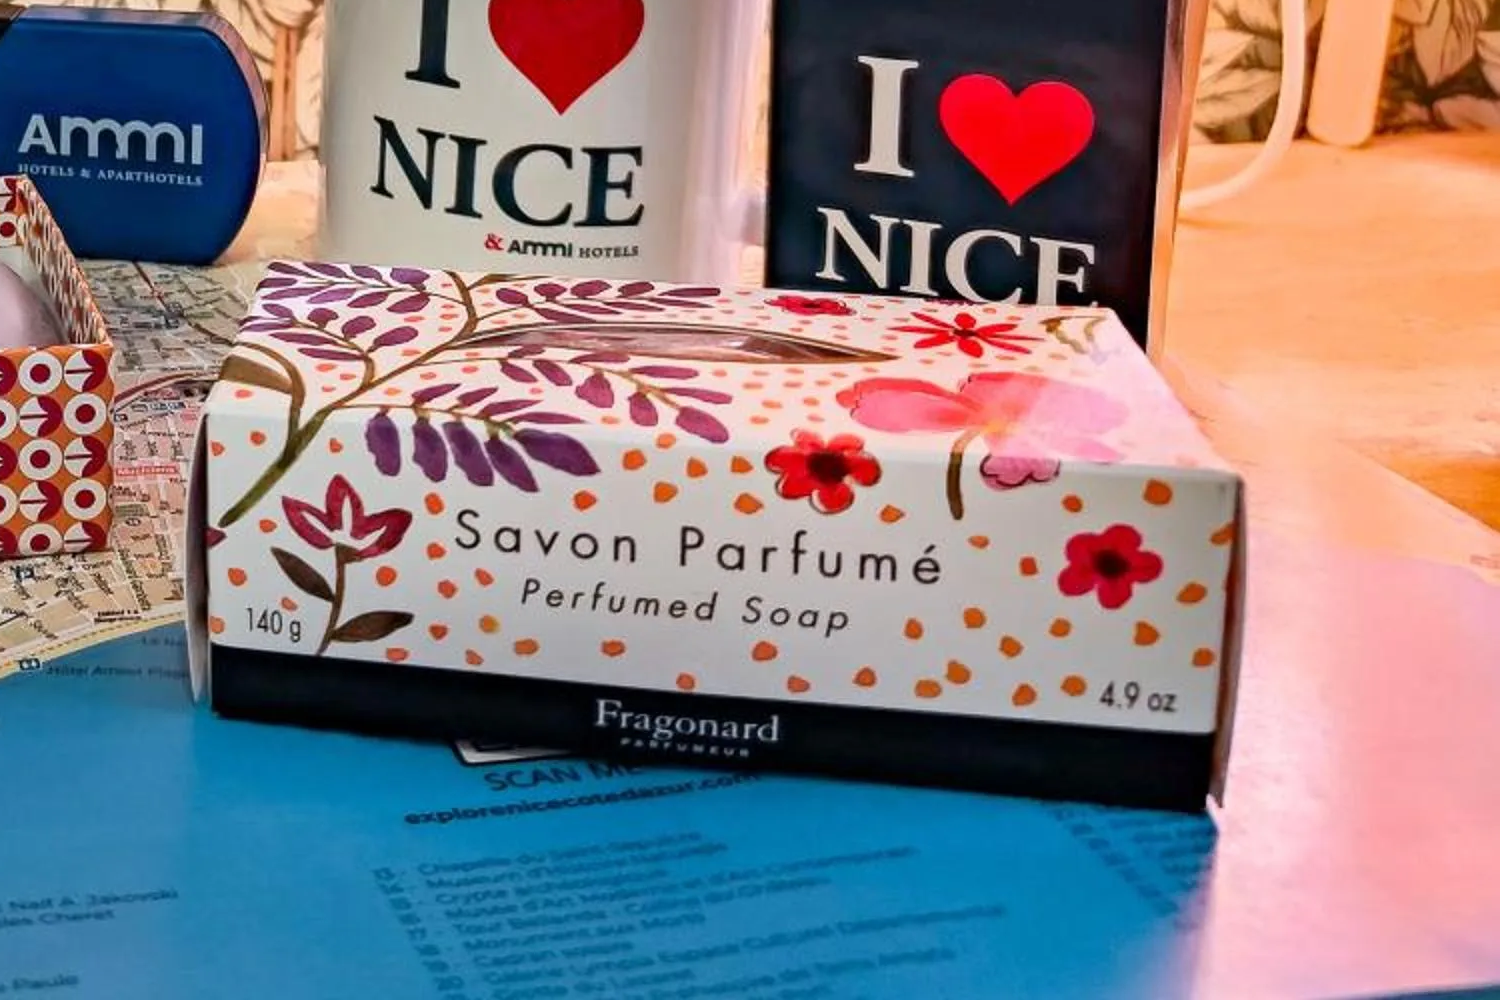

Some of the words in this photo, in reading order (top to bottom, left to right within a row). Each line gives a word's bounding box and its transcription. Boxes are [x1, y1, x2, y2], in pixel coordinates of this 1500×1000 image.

[854, 55, 919, 178] I
[18, 163, 74, 178] HOTELS
[80, 168, 92, 179] &
[97, 169, 203, 186] APARTHOTELS
[370, 115, 645, 228] NICE
[484, 233, 505, 251] &
[579, 245, 639, 259] HOTELS
[815, 206, 1099, 307] NICE
[454, 508, 637, 564] Savon
[678, 526, 942, 585] Parfumé
[245, 607, 284, 636] 140
[289, 616, 302, 642] g
[521, 578, 719, 622] Perfumed
[742, 596, 851, 638] Soap
[1100, 682, 1140, 712] 4.9
[1147, 690, 1179, 713] oz
[593, 698, 780, 743] Fragonard
[620, 737, 751, 758] PARFUMEUR
[483, 763, 582, 793] SCAN
